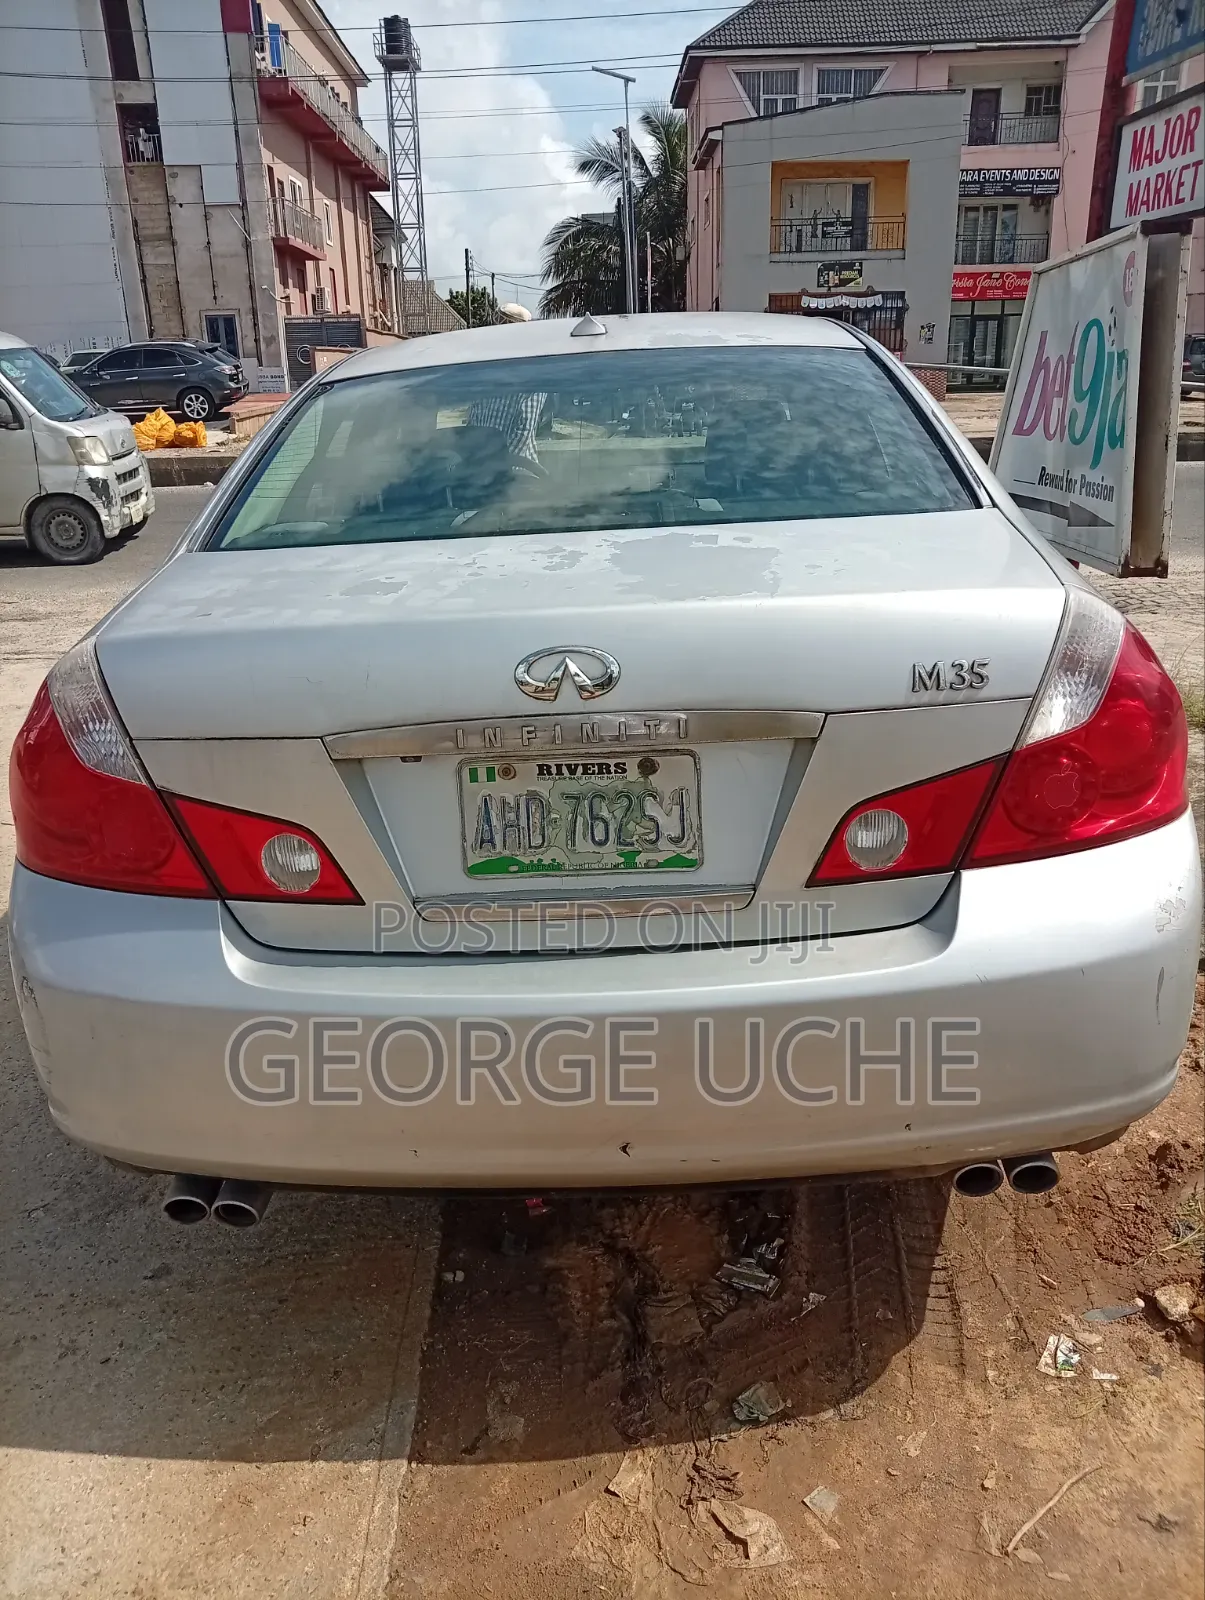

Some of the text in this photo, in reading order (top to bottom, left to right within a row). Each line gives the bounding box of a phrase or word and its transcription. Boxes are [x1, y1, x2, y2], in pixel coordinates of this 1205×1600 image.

[1128, 106, 1202, 174] MAJOR
[980, 169, 1011, 181] EVENTS
[1011, 169, 1029, 180] AND
[1030, 168, 1060, 180] DESIGN
[1125, 160, 1203, 218] MARKET
[1012, 318, 1128, 470] bet9ja
[1038, 466, 1115, 503] Reward for Passion
[912, 657, 991, 692] M35
[456, 713, 688, 749] INFINITI
[536, 761, 628, 777] RIVERS
